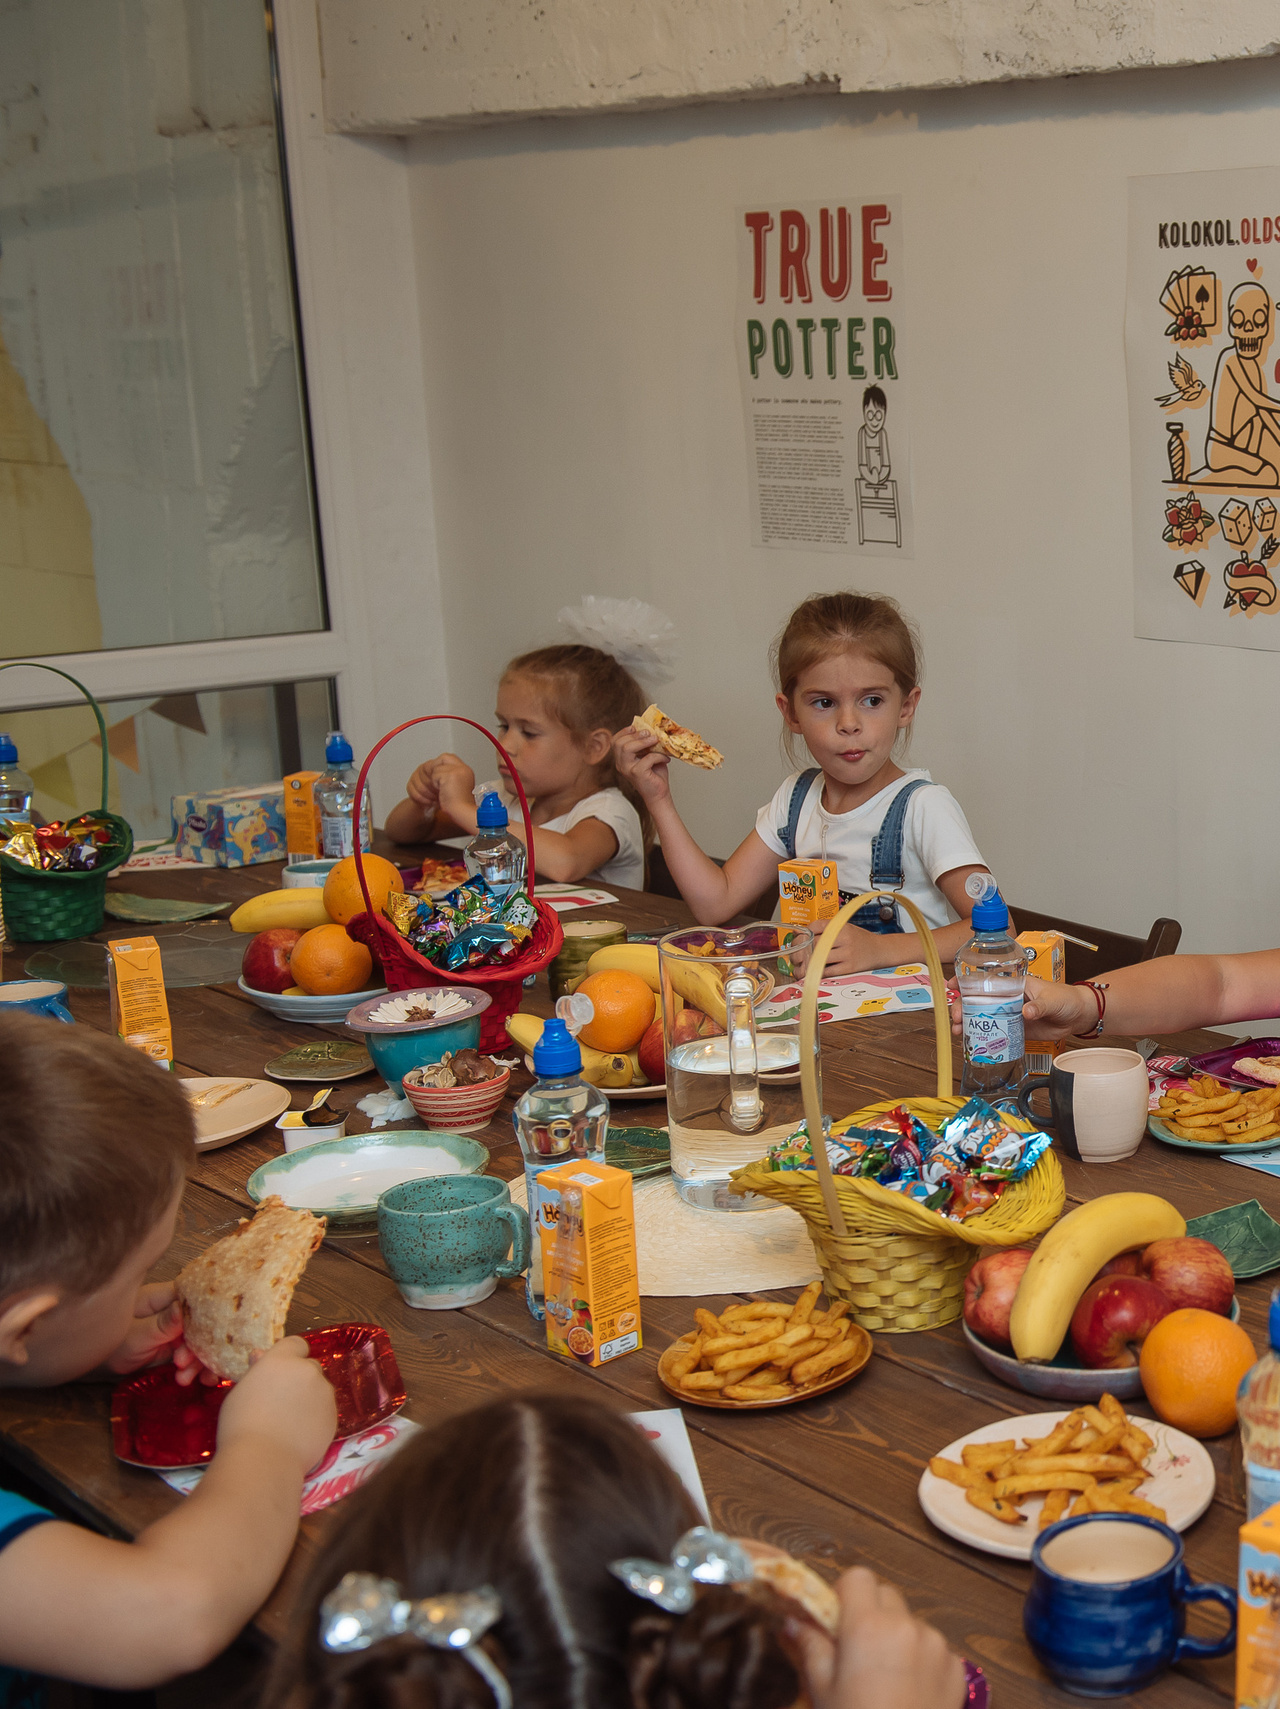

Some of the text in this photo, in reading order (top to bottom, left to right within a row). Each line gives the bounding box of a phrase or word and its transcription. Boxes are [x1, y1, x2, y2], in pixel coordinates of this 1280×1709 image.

[745, 204, 892, 304] TRUE
[747, 317, 898, 380] POTTER
[969, 1018, 999, 1031] АКВА
[543, 1204, 584, 1234] Hony
